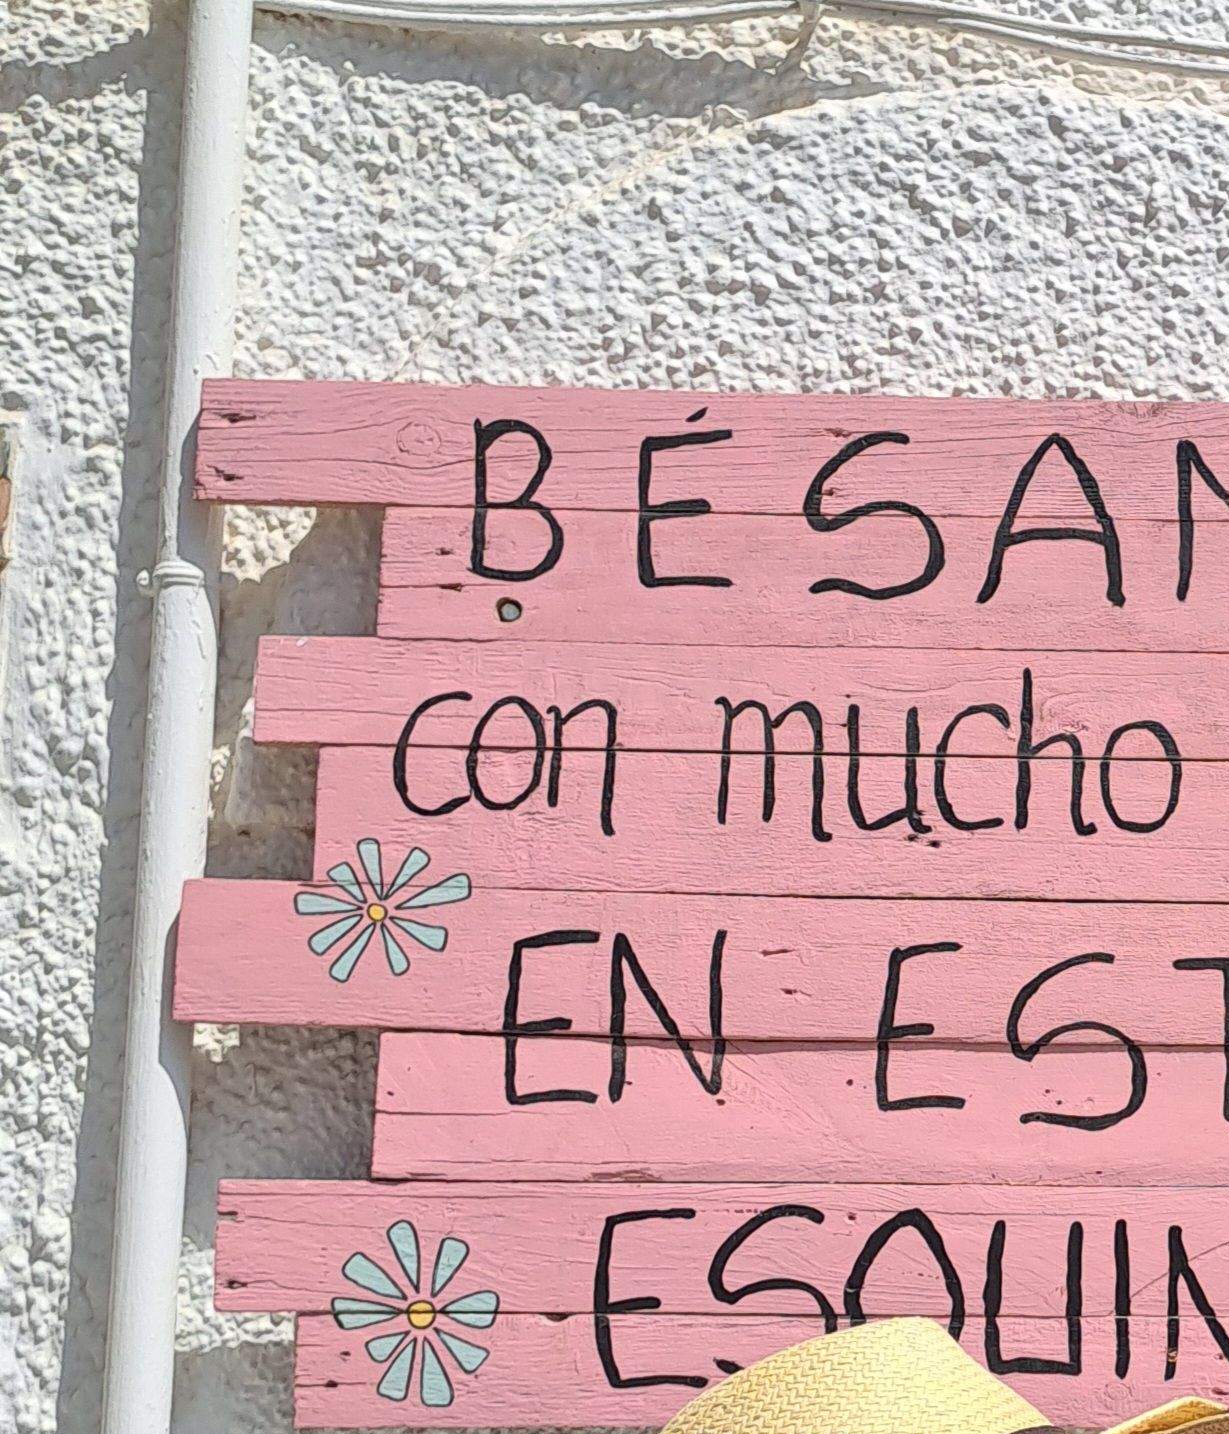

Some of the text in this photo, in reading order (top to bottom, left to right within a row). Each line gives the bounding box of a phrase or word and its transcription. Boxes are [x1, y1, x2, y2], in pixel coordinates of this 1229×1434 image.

[393, 690, 616, 836] con
[716, 667, 1179, 843] mucho
[500, 928, 727, 1106] EN
